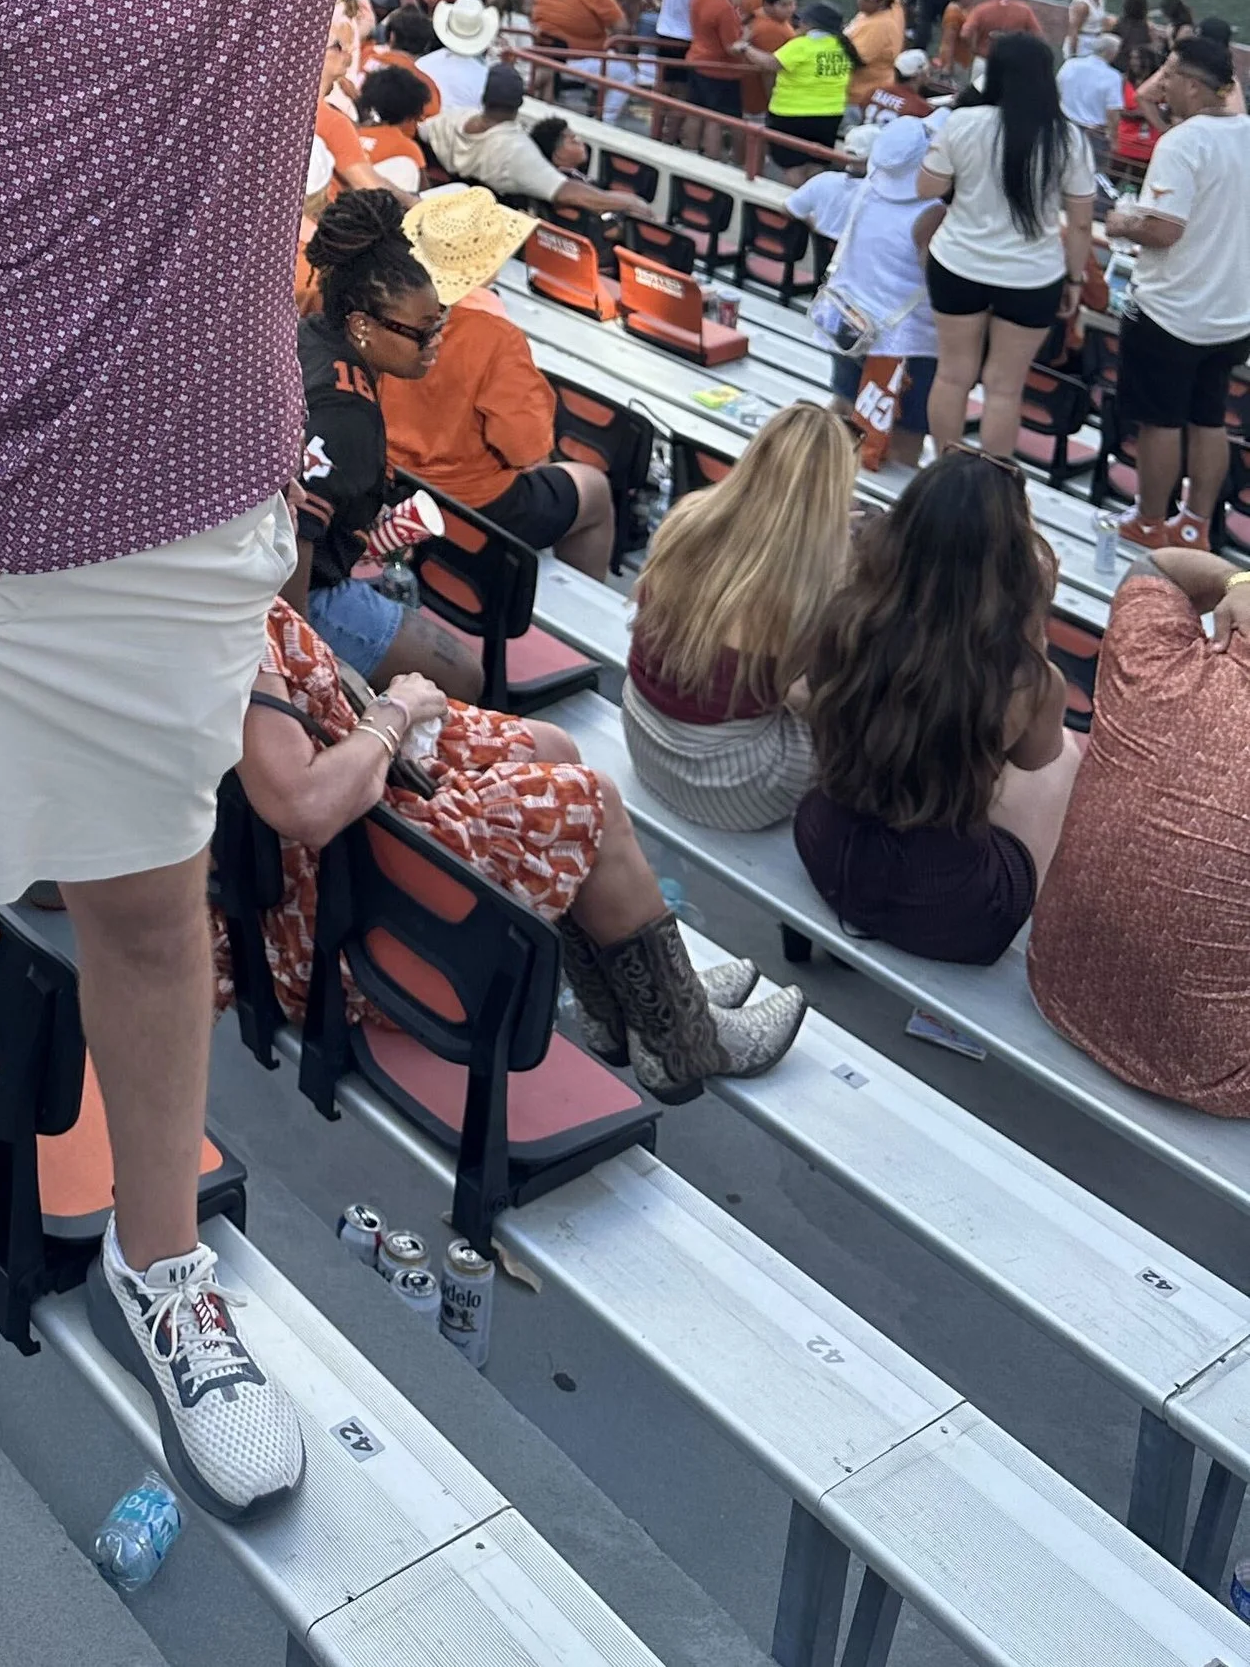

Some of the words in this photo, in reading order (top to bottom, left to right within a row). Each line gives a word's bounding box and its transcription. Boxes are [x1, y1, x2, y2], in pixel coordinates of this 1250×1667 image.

[1142, 1270, 1172, 1290] 42
[806, 1335, 845, 1363] 42
[339, 1421, 374, 1451] 42
